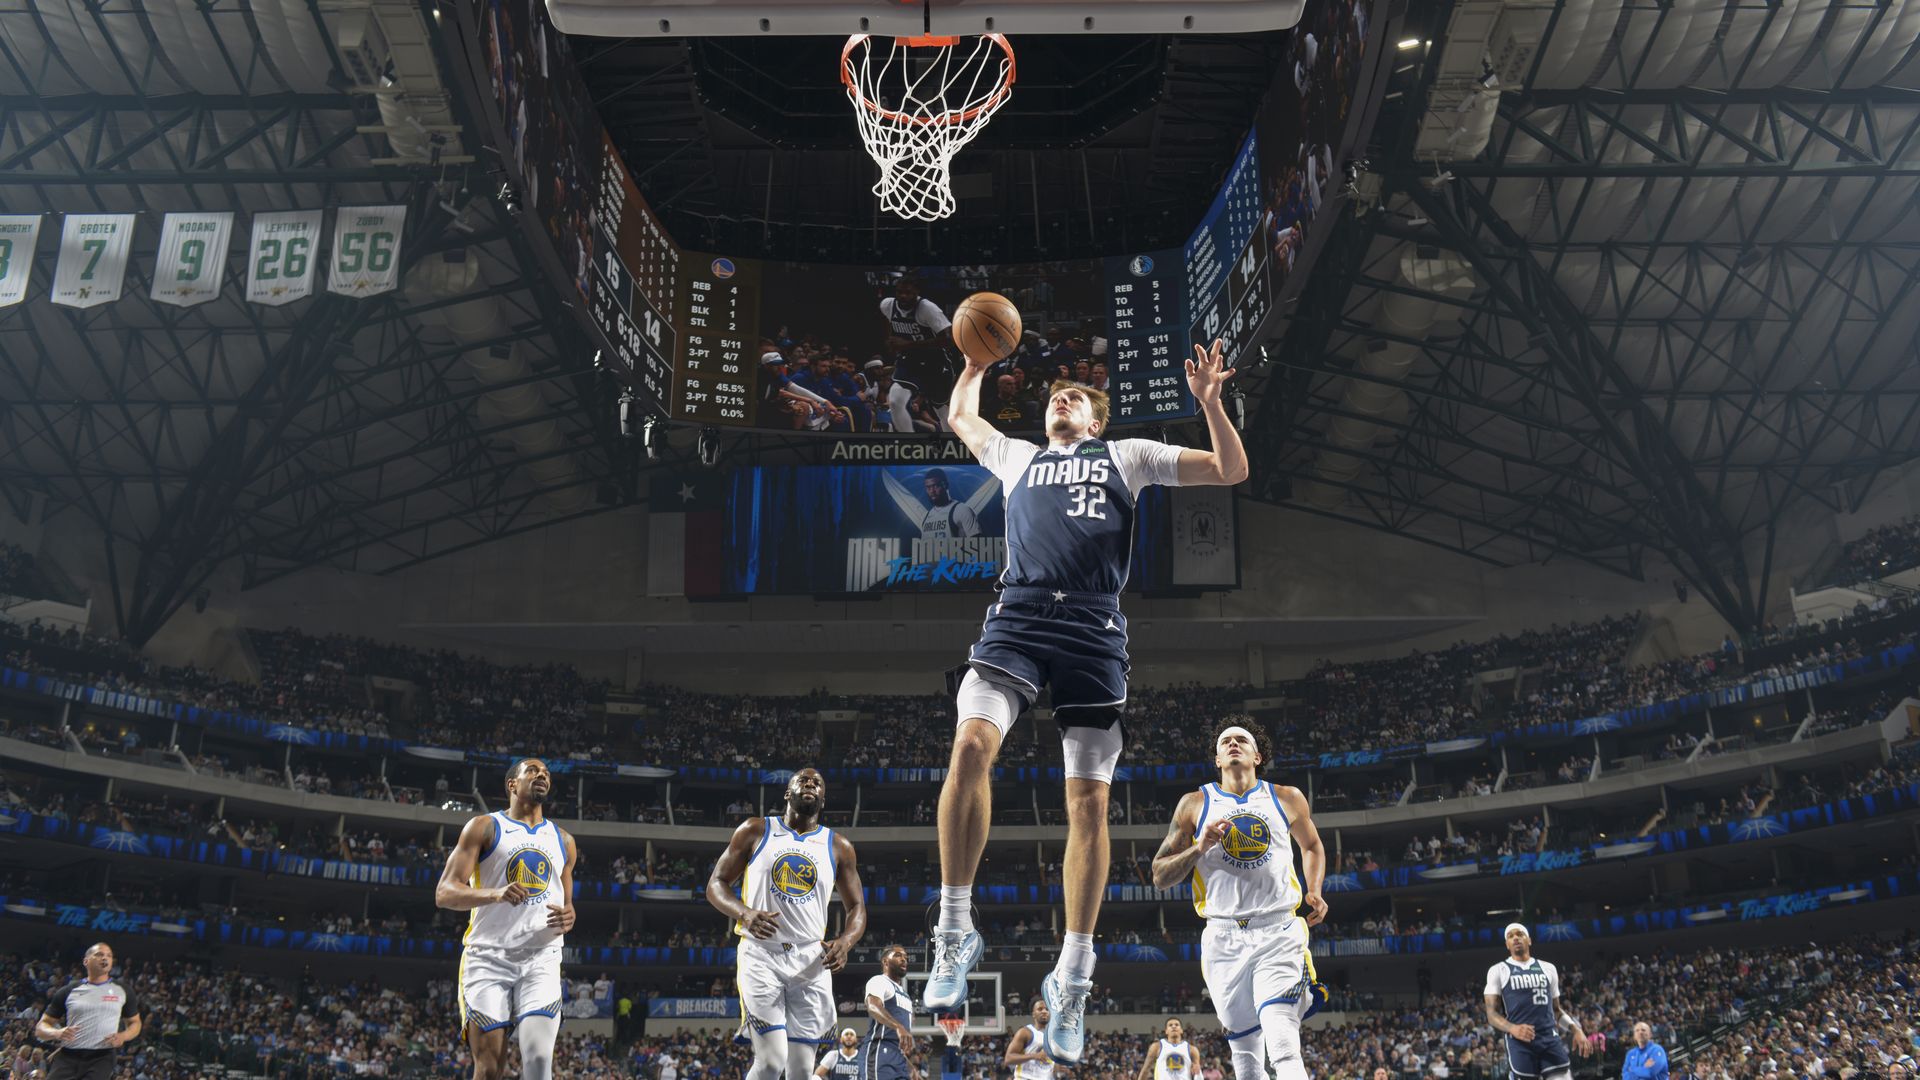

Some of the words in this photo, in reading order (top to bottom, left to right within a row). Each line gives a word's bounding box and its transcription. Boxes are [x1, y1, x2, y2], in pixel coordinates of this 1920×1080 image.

[80, 223, 117, 234] BROTEN
[179, 222, 217, 233] MODANO
[265, 222, 308, 233] LEHTINEN
[256, 237, 310, 280] 26
[339, 231, 394, 273] 56
[80, 240, 107, 280] 7
[176, 240, 206, 280] 9
[1241, 244, 1256, 285] 14
[605, 251, 619, 290] 15
[693, 281, 711, 291] REB
[1114, 284, 1133, 293] REB
[607, 297, 612, 310] 7
[692, 294, 705, 302] TO
[1115, 297, 1128, 305] TO
[1153, 293, 1160, 301] 2
[691, 305, 710, 315] BLK
[1115, 308, 1134, 317] BLK
[606, 319, 610, 332] 0
[644, 310, 660, 347] 14
[690, 318, 707, 327] STL
[729, 322, 736, 330] 2
[1116, 320, 1133, 329] STL
[1154, 316, 1161, 325] 0
[1203, 304, 1219, 341] 15
[617, 313, 640, 356] 6:18
[1222, 309, 1244, 353] 6:18
[689, 336, 702, 345] FG
[721, 339, 741, 349] 5/11
[1117, 338, 1130, 347] FG
[1148, 334, 1169, 344] 6/11
[689, 348, 710, 358] 3-PT
[723, 352, 739, 361] 4/7
[1118, 350, 1139, 359] 3-PT
[1152, 346, 1168, 356] 3/5
[630, 359, 633, 371] 1
[646, 353, 657, 373] TOL
[659, 367, 664, 378] 7
[688, 361, 700, 369] FT
[722, 364, 739, 373] 0/0
[1118, 363, 1130, 372] FT
[1152, 359, 1169, 368] 0/0
[644, 373, 655, 391] FLS
[657, 387, 662, 400] 2
[687, 379, 700, 388] FG
[716, 383, 745, 393] 45.5%
[1120, 382, 1133, 391] FG
[1148, 377, 1178, 387] 54.5%
[686, 392, 708, 402] 3-PT
[715, 395, 745, 405] 57.1%
[1120, 393, 1141, 403] 3-PT
[1149, 389, 1179, 400] 60.0%
[685, 404, 697, 413] FT
[720, 408, 744, 418] 0.0%
[1121, 407, 1132, 415] FT
[1156, 402, 1180, 412] 0.0%
[1081, 447, 1106, 455] chime
[1027, 458, 1110, 488] MAVS
[1066, 485, 1107, 520] 32
[924, 519, 946, 532] DALLAS
[846, 538, 900, 591] NAJI
[911, 537, 1009, 578] MARSHA
[885, 556, 932, 587] THE
[931, 554, 1000, 585] KNIFE
[1752, 668, 1837, 698] MARSHALL
[91, 688, 176, 719] MARSHALL
[1319, 753, 1342, 768] THE
[1222, 808, 1246, 820] OLDEN
[1250, 823, 1263, 838] 15
[508, 843, 535, 856] GOLDEN
[774, 847, 800, 858] GOLDEN
[1222, 850, 1272, 870] WARRIORS
[1499, 855, 1532, 876] THE
[1536, 850, 1582, 871] KNIFE
[323, 862, 411, 885] MARSHALL
[537, 861, 546, 875] 8
[797, 864, 813, 878] 23
[523, 890, 551, 906] RIORS
[769, 884, 816, 905] WARRIORS
[1122, 885, 1192, 901] MARSHAL
[1739, 899, 1771, 920] THE
[1776, 895, 1820, 917] KNIFE
[56, 905, 86, 926] THE
[91, 909, 142, 932] KNIFE
[1335, 937, 1391, 956] MARSHALL
[1510, 973, 1548, 990] MAVS
[1532, 988, 1549, 1005] 25
[676, 999, 726, 1016] BREAKERS
[836, 1063, 859, 1075] MAVS
